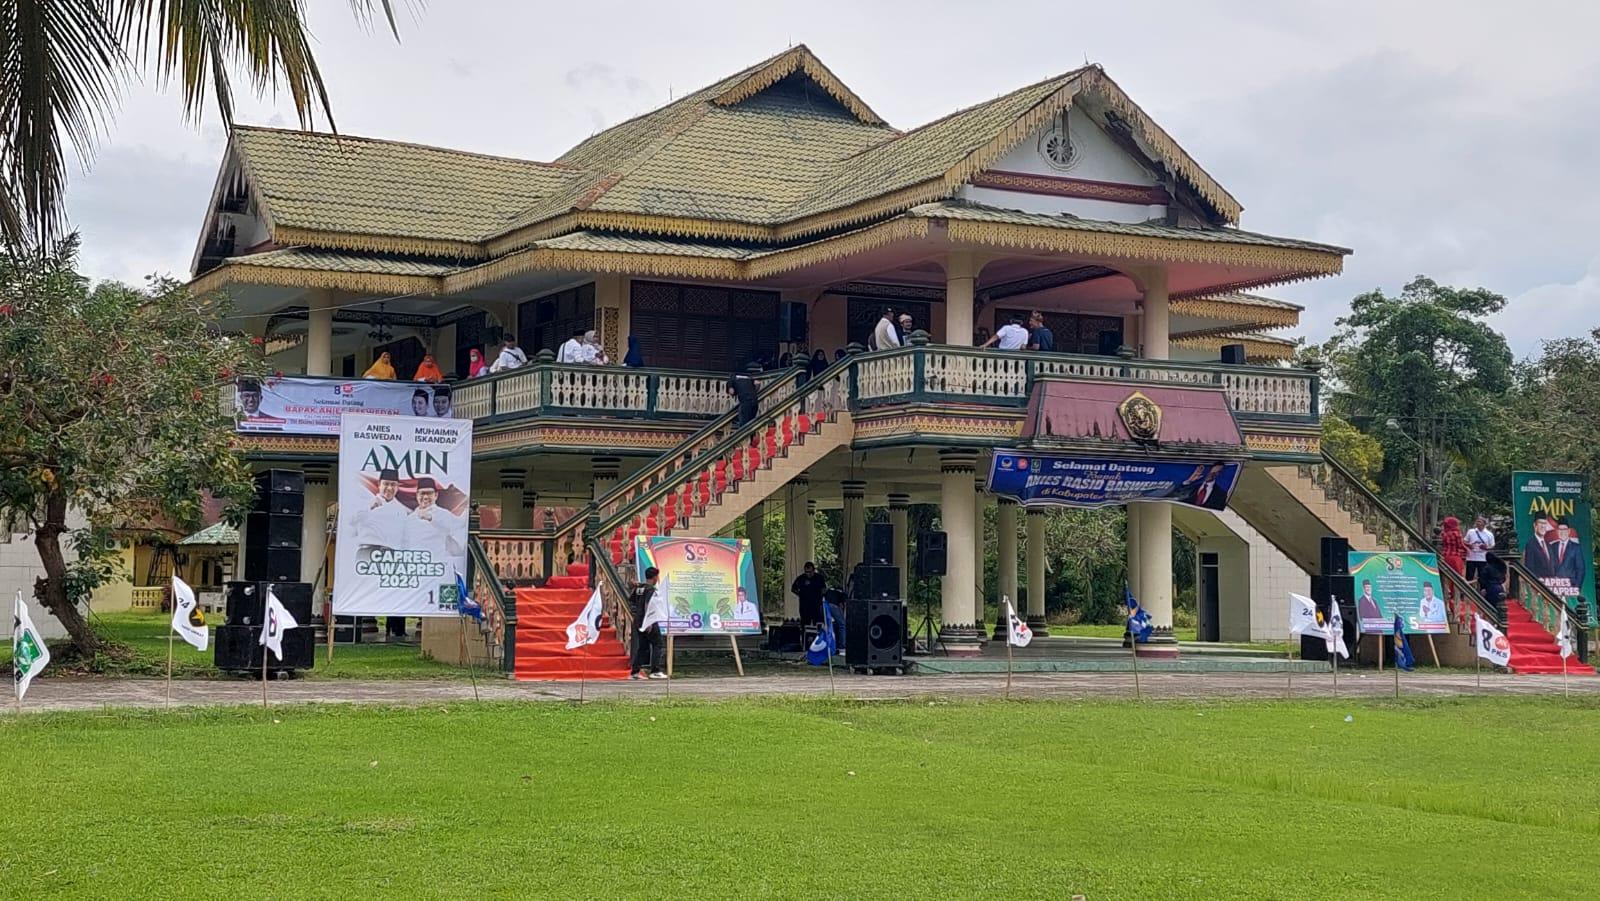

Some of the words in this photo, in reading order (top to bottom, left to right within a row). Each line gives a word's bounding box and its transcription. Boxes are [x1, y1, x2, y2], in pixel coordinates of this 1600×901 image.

[334, 385, 341, 395] 8
[285, 405, 316, 414] BAPAK
[366, 424, 391, 433] ANIES
[415, 428, 458, 437] MUHAIMIN
[354, 432, 402, 441] BASWEDAN
[415, 436, 457, 444] ISKANDAR
[360, 444, 449, 479] AMIN
[1052, 461, 1106, 471] Selamat
[1108, 463, 1155, 474] Datang
[1025, 475, 1062, 488] ANIES
[1528, 496, 1575, 520] AMIN
[370, 549, 431, 563] CAPRES
[356, 561, 445, 576] CAWAPRES
[380, 574, 419, 588] 2024
[691, 613, 703, 629] 8
[710, 613, 722, 629] 8
[1481, 629, 1493, 652] 8
[1491, 648, 1508, 659] PKS
